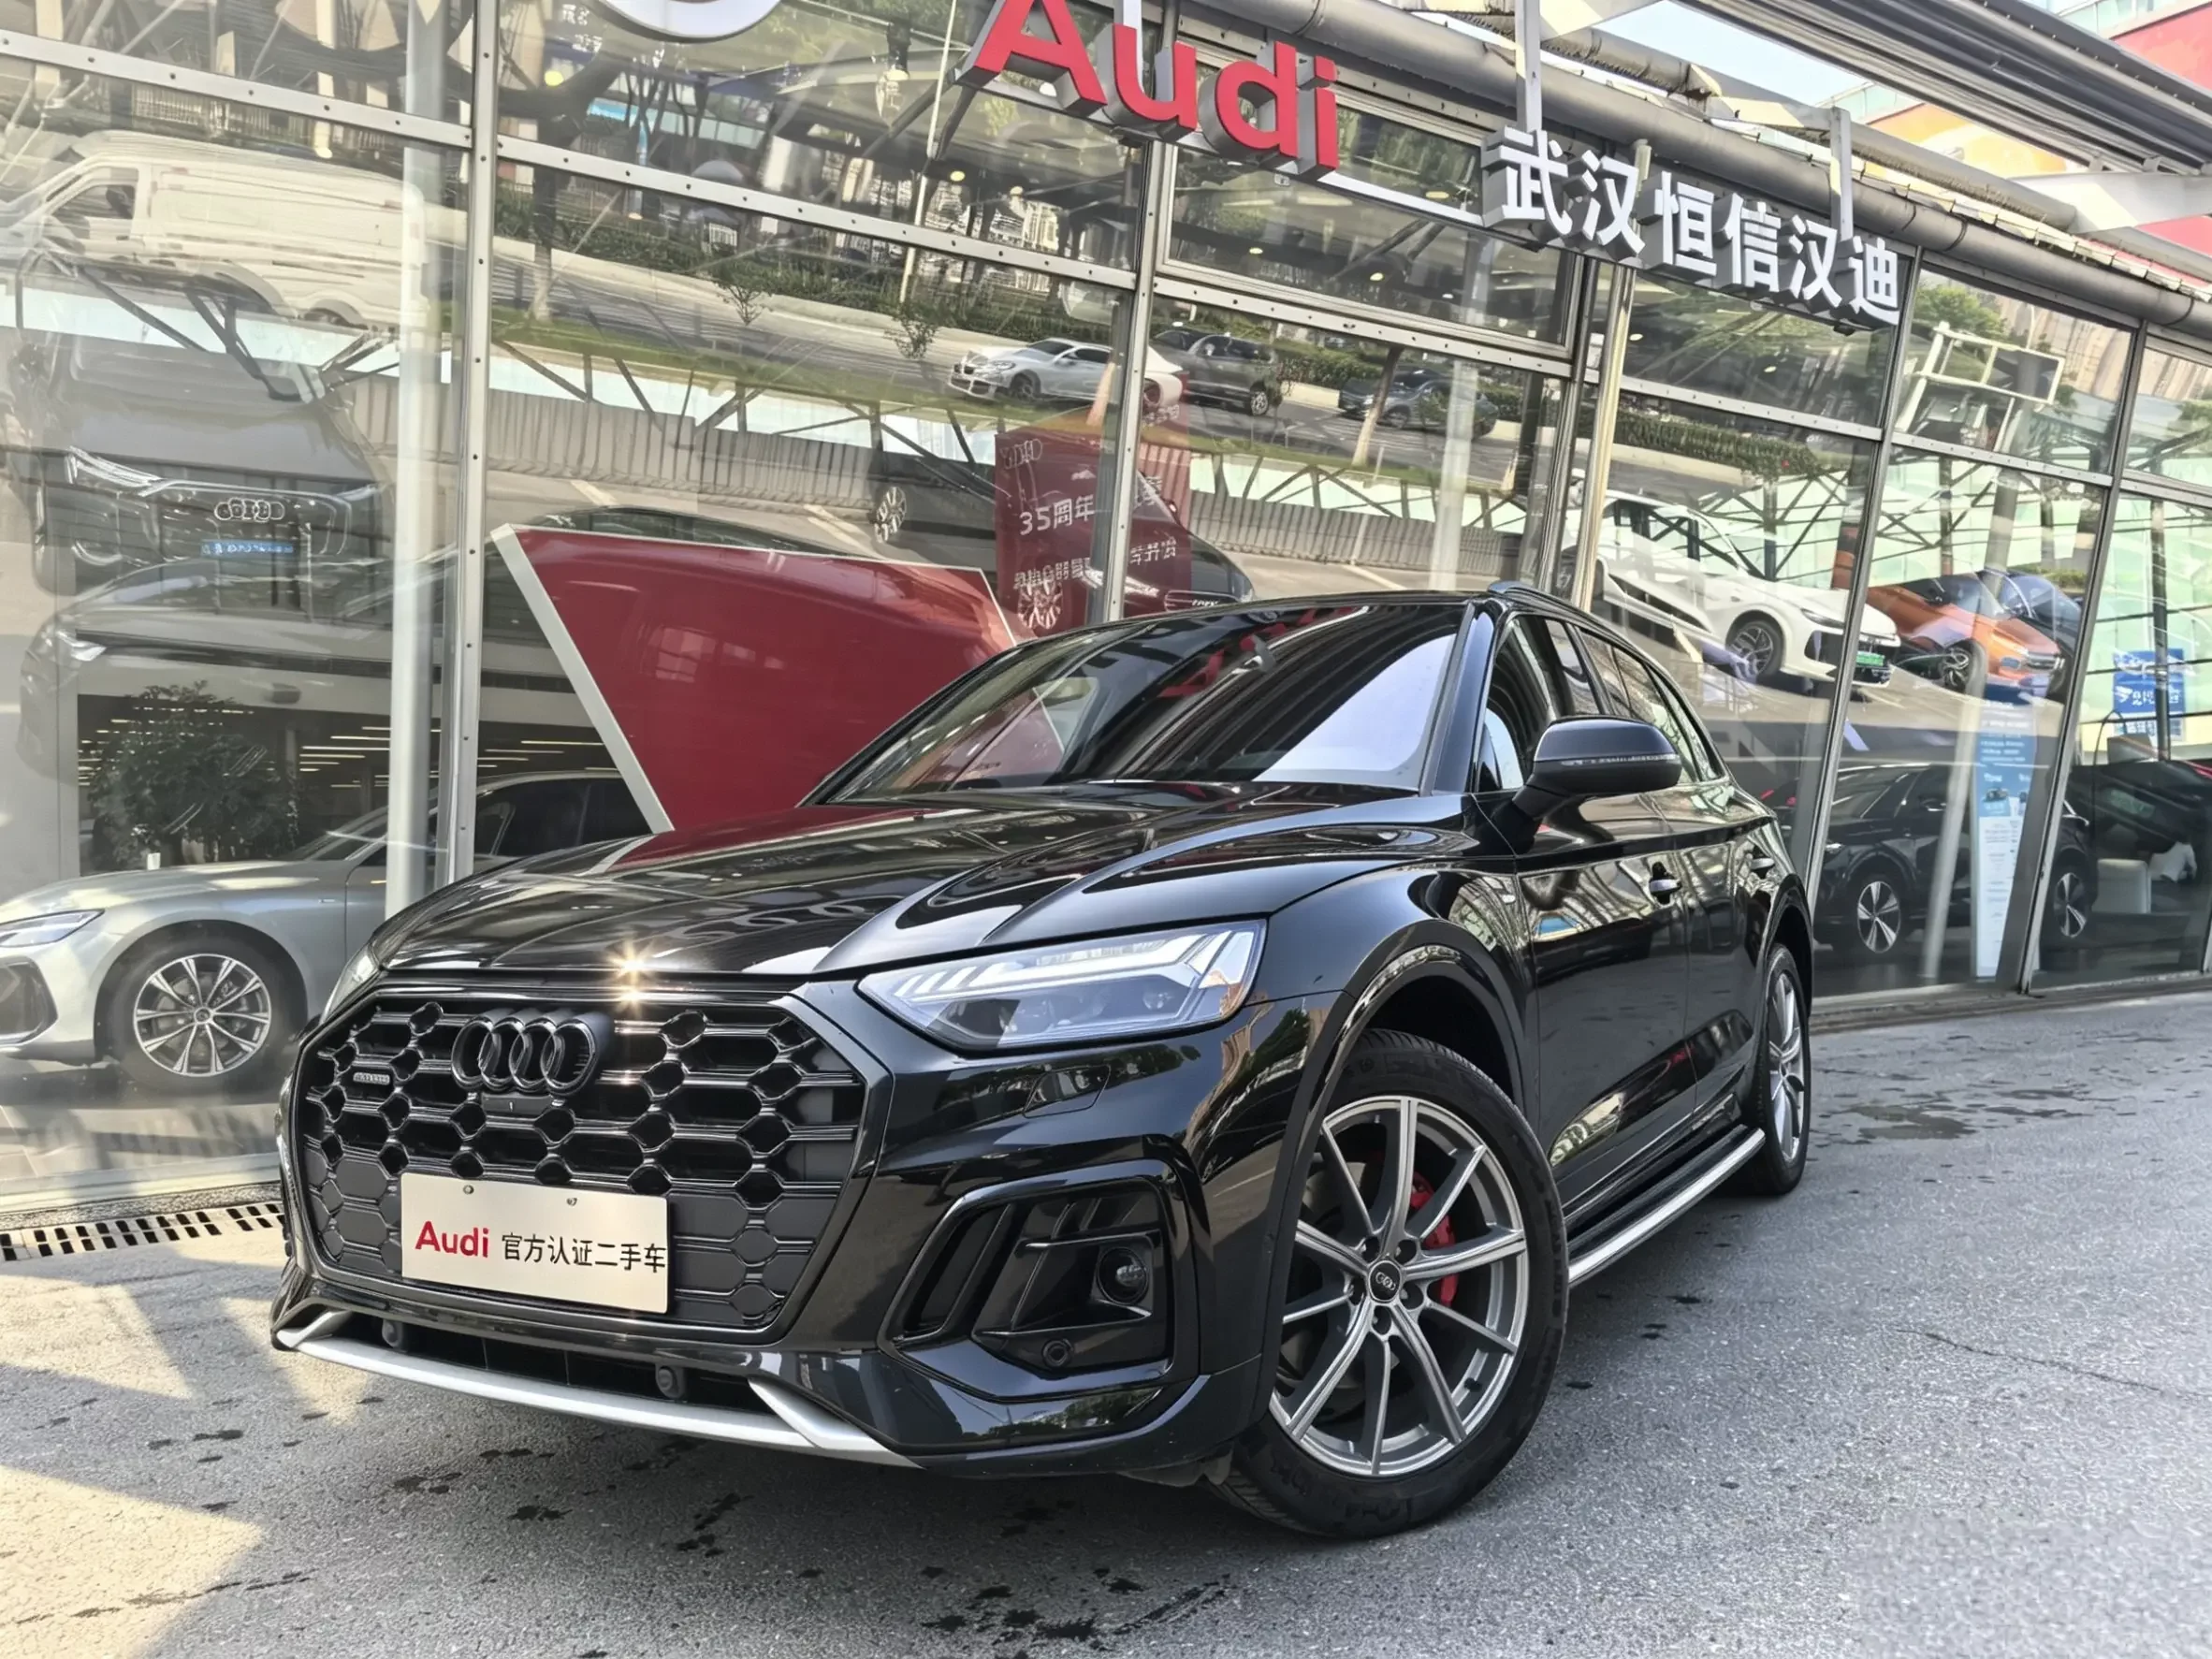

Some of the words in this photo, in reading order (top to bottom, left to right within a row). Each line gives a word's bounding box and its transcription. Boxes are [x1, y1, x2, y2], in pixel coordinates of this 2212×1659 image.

[969, 0, 1339, 171] Audi
[1484, 127, 1899, 326] 武汉恒信汉迪
[415, 1220, 489, 1259] Audi
[502, 1232, 667, 1273] 官方认证二手车
